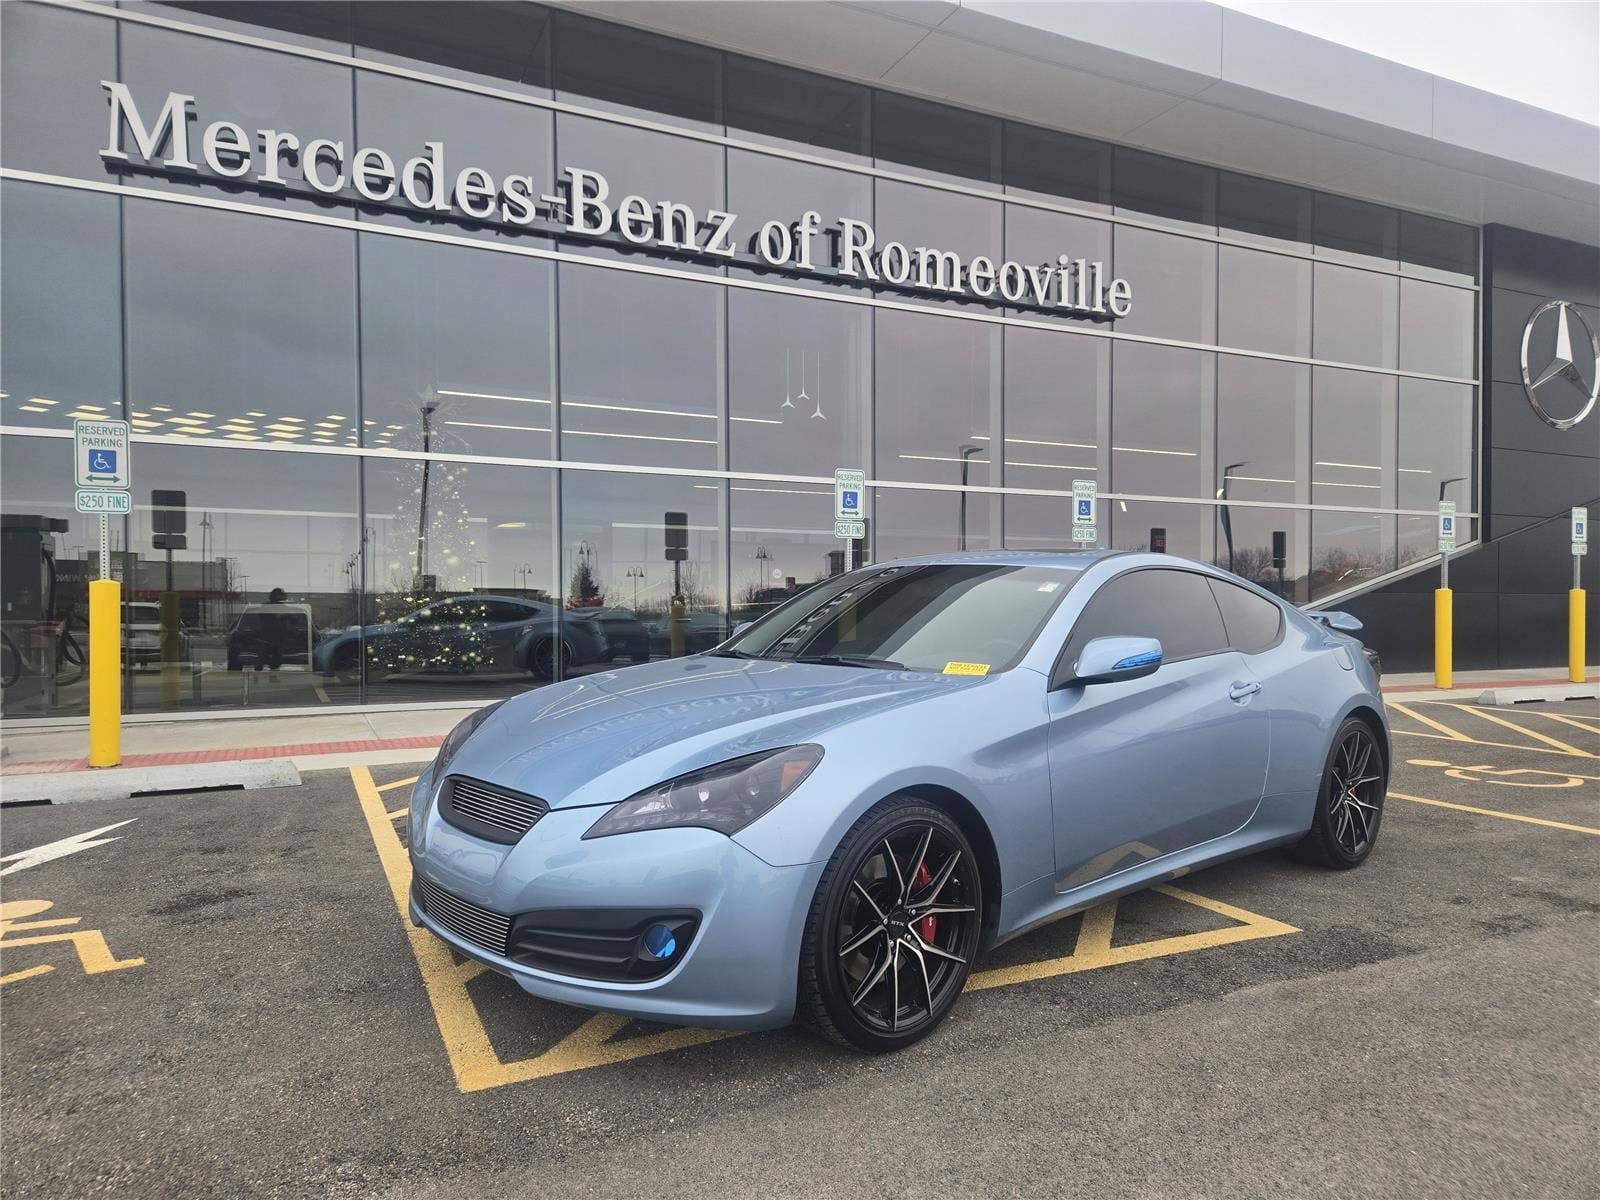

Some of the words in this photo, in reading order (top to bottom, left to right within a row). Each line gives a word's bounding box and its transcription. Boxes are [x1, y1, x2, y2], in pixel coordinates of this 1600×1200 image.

[99, 80, 738, 257] Mercedes-Benz
[759, 210, 822, 270] of
[838, 216, 1133, 317] Romeoville
[78, 425, 125, 437] RESERVED
[82, 437, 122, 447] PARKING
[79, 495, 104, 508] $250
[107, 496, 127, 509] FINE
